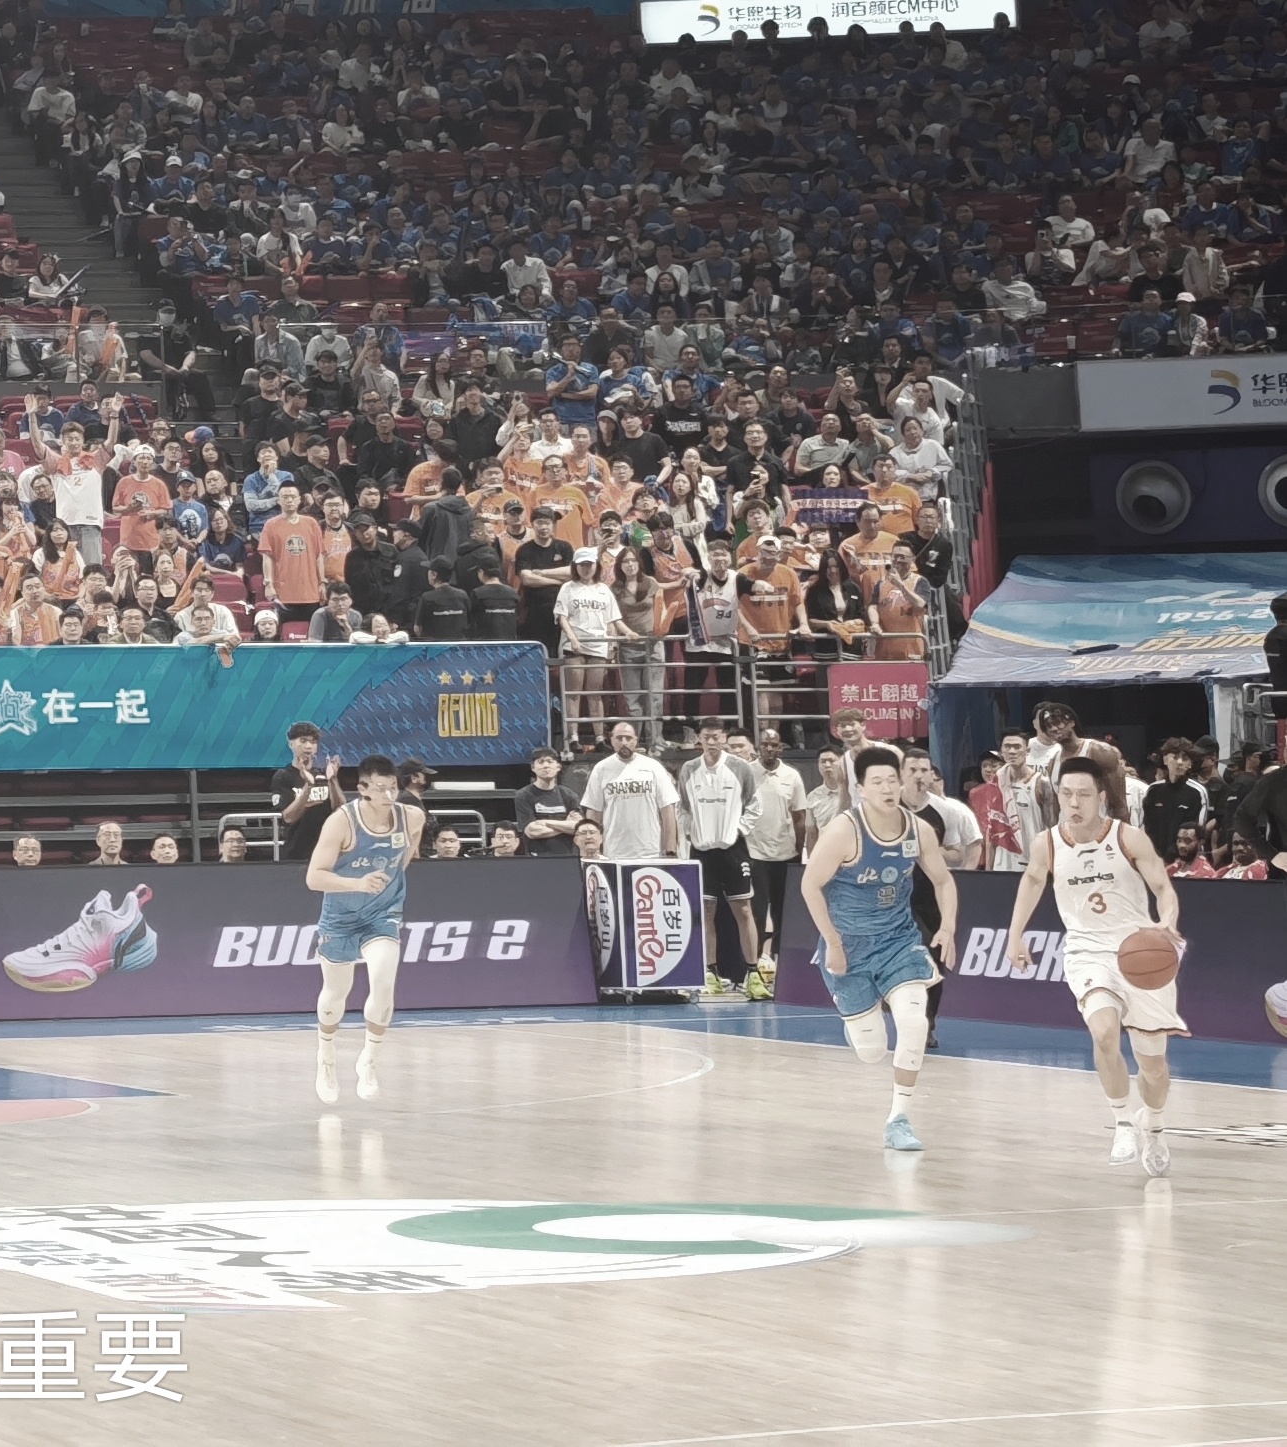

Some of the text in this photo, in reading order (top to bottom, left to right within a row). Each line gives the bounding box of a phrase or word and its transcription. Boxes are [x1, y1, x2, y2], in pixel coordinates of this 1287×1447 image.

[42, 689, 151, 726] 在一起
[438, 692, 499, 738] BEIJING
[662, 888, 683, 951] 百岁山
[1088, 893, 1107, 914] 3
[212, 919, 530, 968] BUCTS 2
